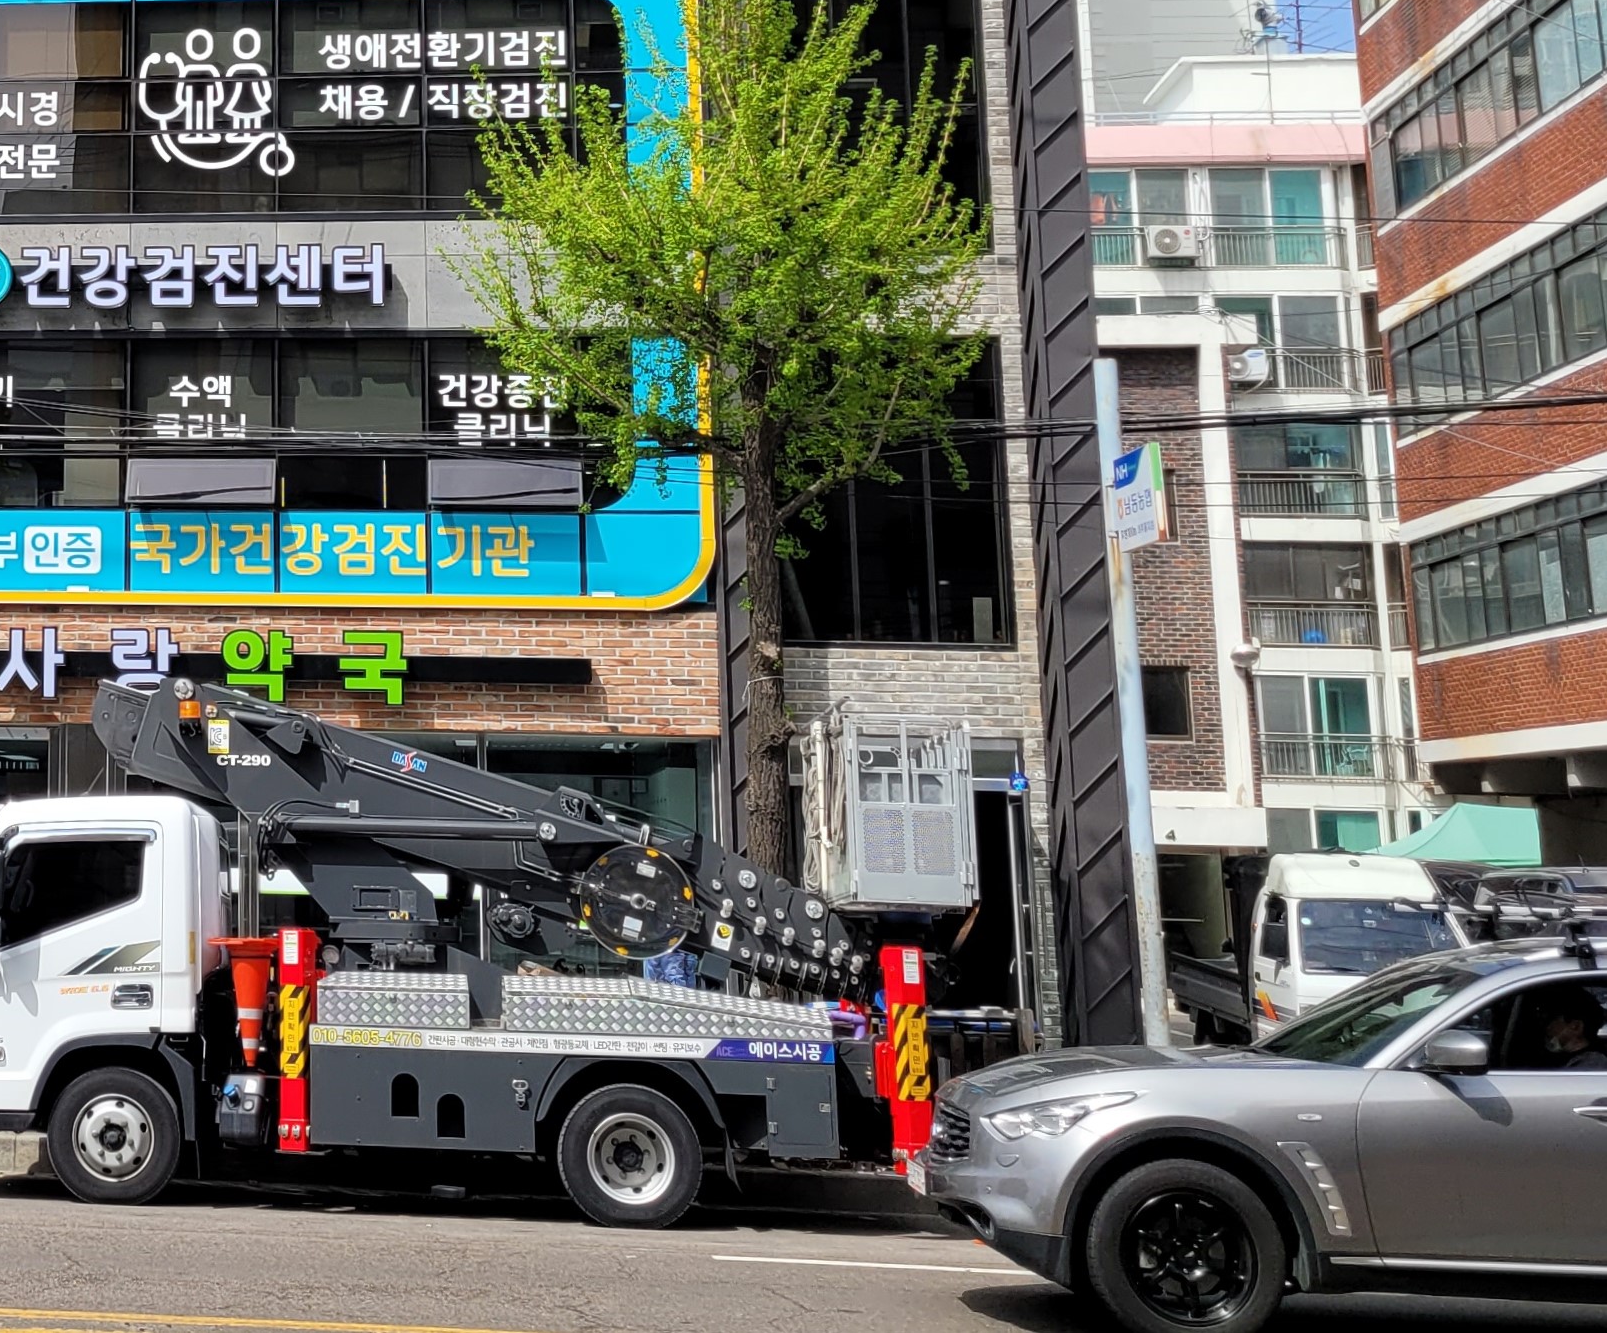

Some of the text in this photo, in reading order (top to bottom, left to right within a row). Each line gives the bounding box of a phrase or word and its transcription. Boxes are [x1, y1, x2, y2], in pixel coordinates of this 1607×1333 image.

[318, 30, 567, 70] 생애전환기검진
[318, 83, 389, 121] 채용
[427, 82, 567, 119] 직장검진
[19, 243, 387, 310] 건강검진센터
[169, 375, 232, 408] 수액
[1115, 462, 1129, 482] NH
[216, 754, 272, 767] CT-290
[113, 964, 156, 973] MIGHTY
[311, 1027, 423, 1047] 010-5605-4776
[748, 1041, 823, 1061] 에이스시공
